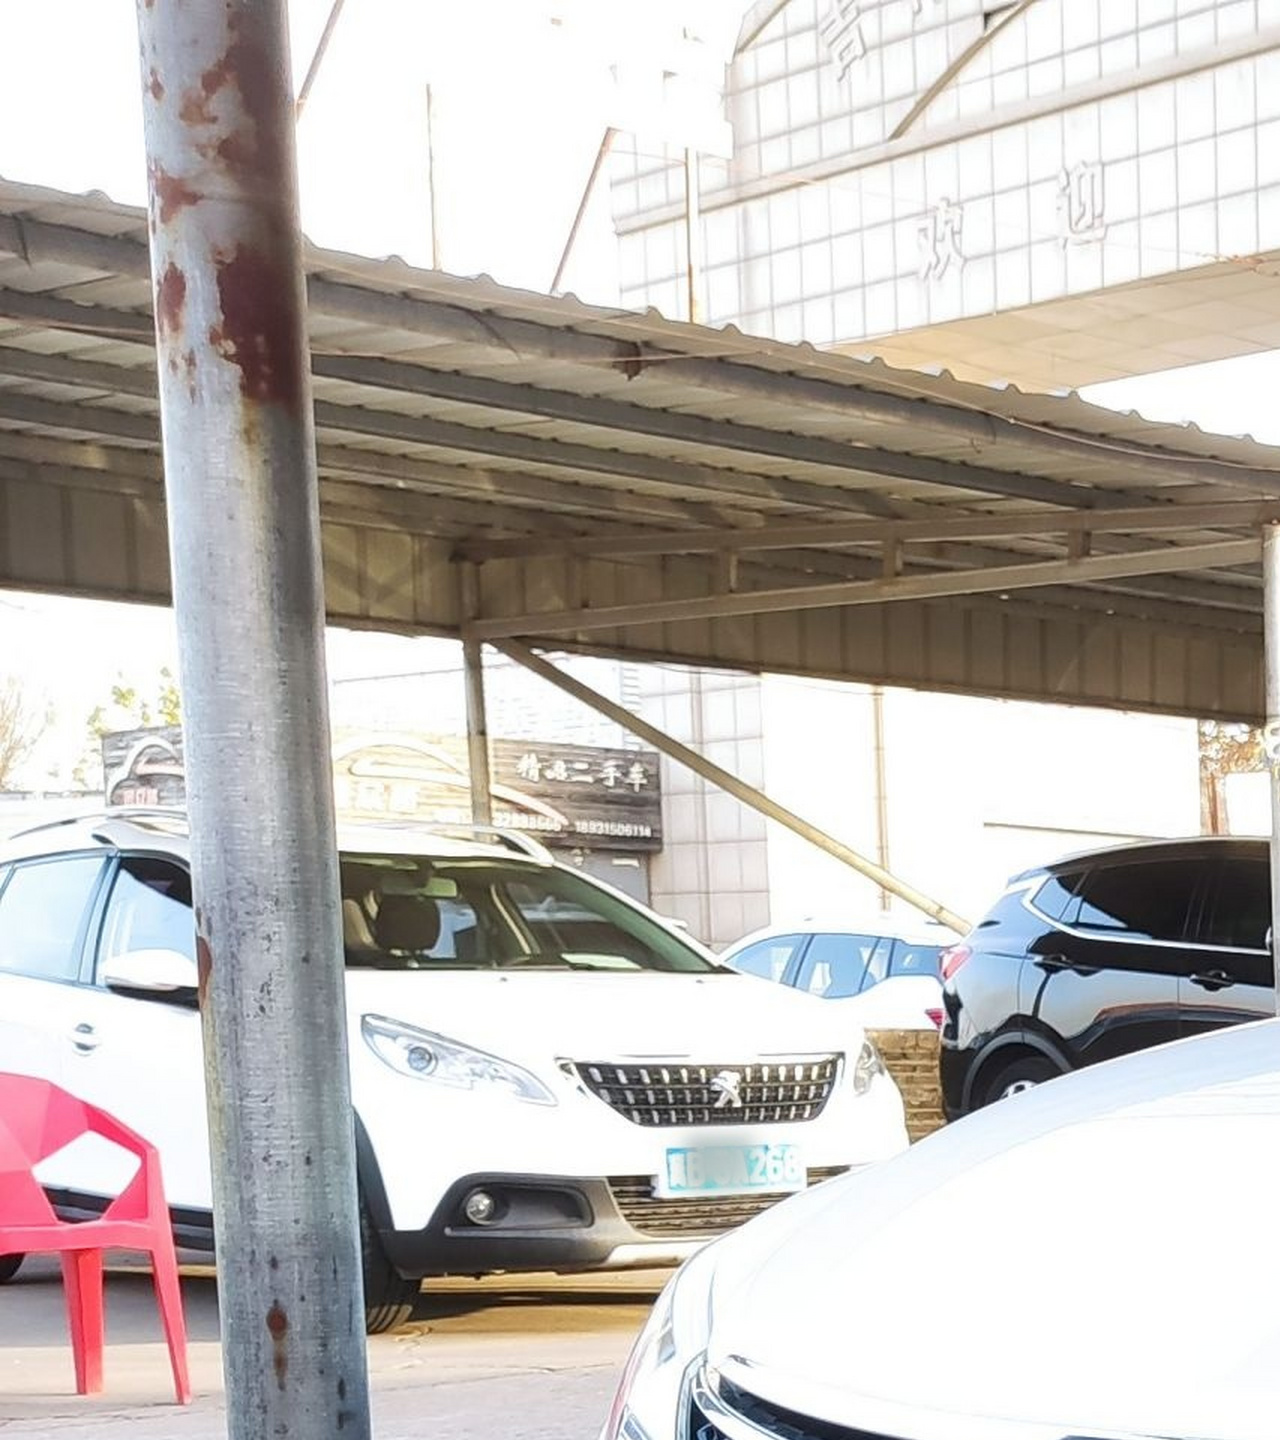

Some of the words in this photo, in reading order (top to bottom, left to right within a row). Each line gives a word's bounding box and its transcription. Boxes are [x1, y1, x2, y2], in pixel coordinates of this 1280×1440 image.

[516, 753, 648, 793] 精品二手车
